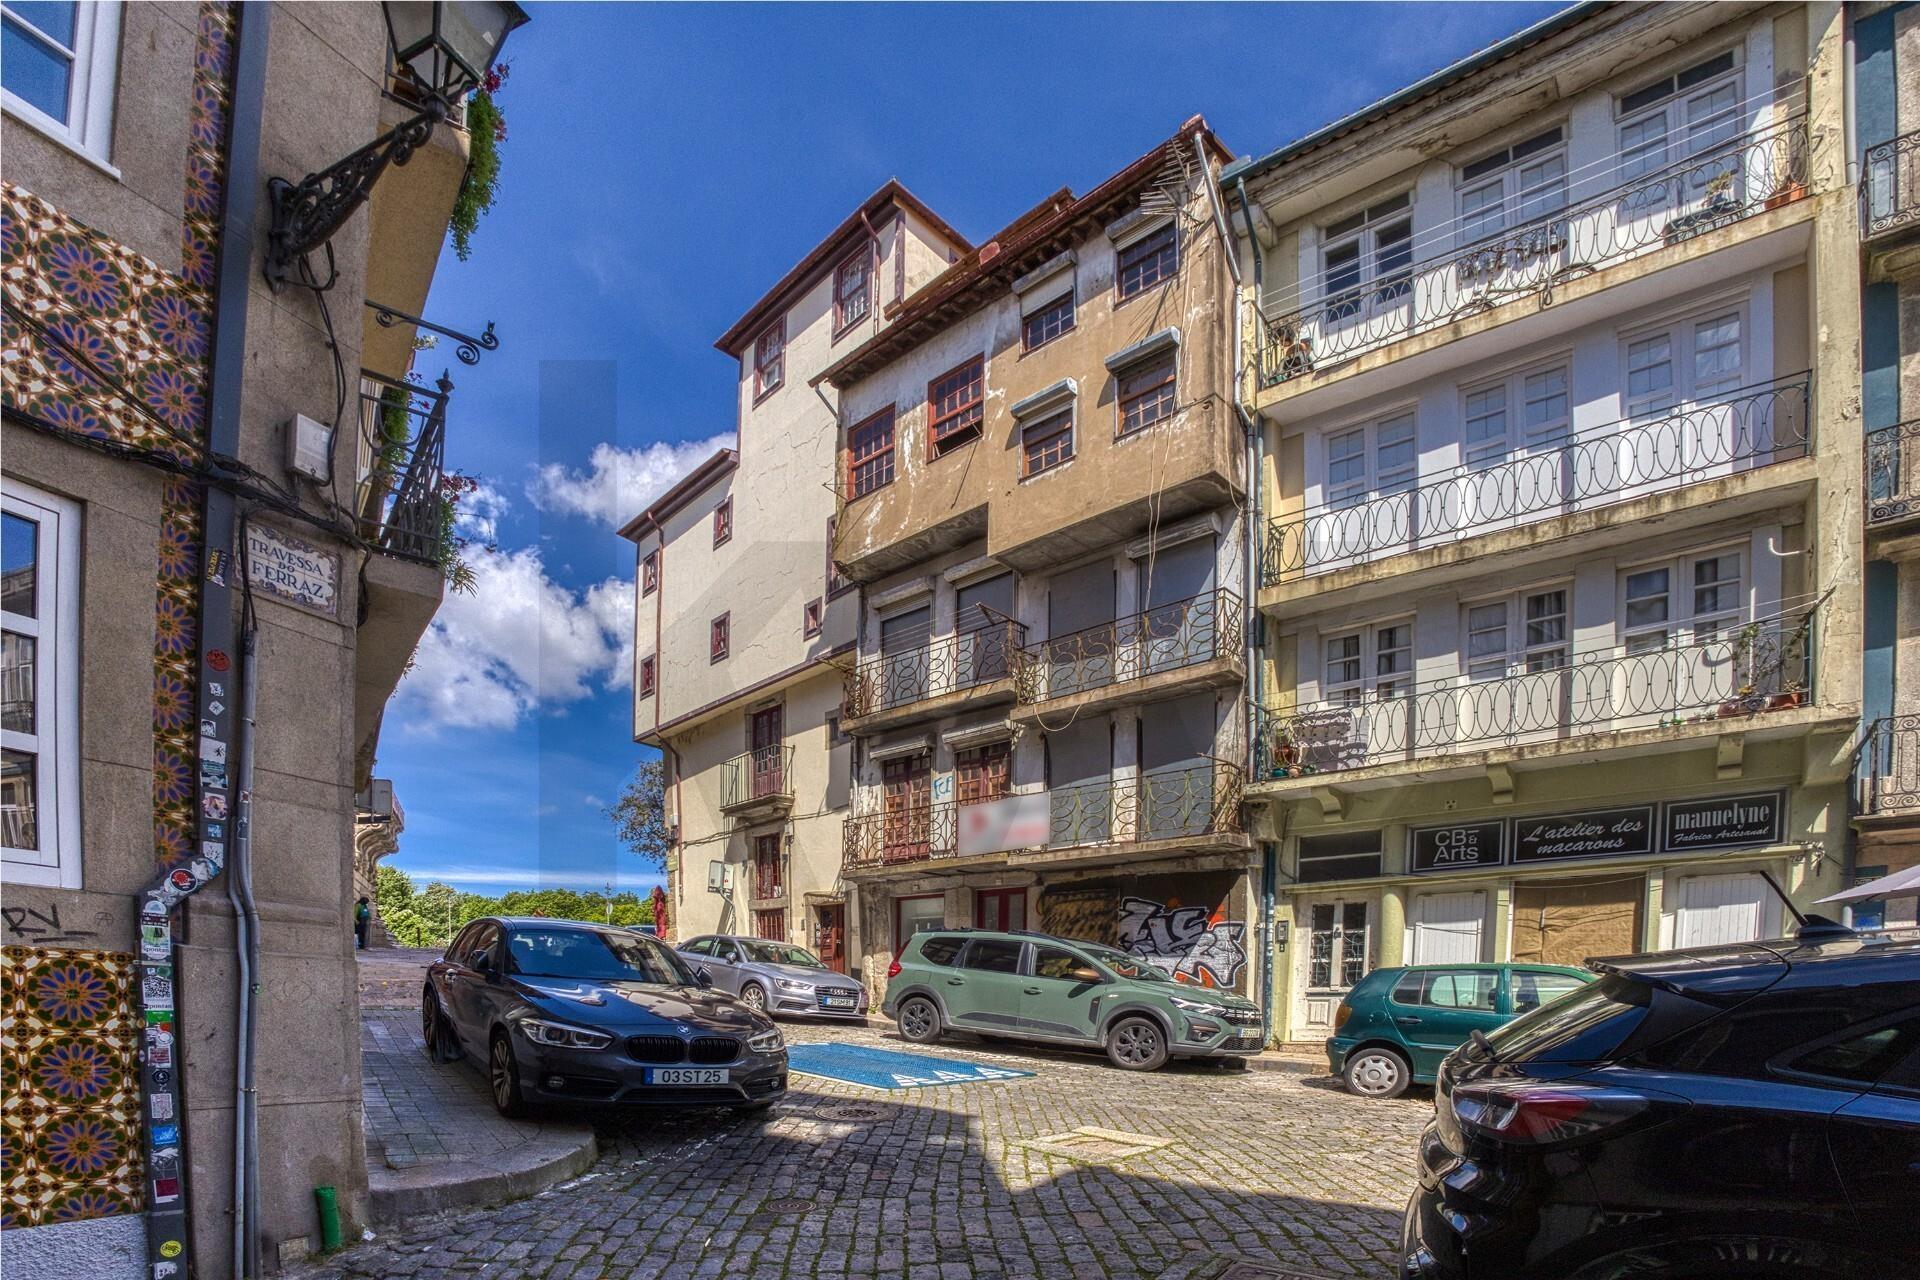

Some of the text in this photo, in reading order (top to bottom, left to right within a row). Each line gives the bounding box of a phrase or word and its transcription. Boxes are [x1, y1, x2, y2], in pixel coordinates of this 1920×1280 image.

[248, 537, 324, 577] TRAVESSA
[278, 562, 295, 573] DO
[252, 560, 324, 598] FERRAZ
[1674, 802, 1770, 831] manuelyne
[1523, 818, 1644, 842] L'atelier des
[1673, 826, 1769, 844] Fabrico Artesanal
[1433, 845, 1479, 863] Arts
[1537, 836, 1625, 854] macarons
[662, 1070, 721, 1083] 03ST25
